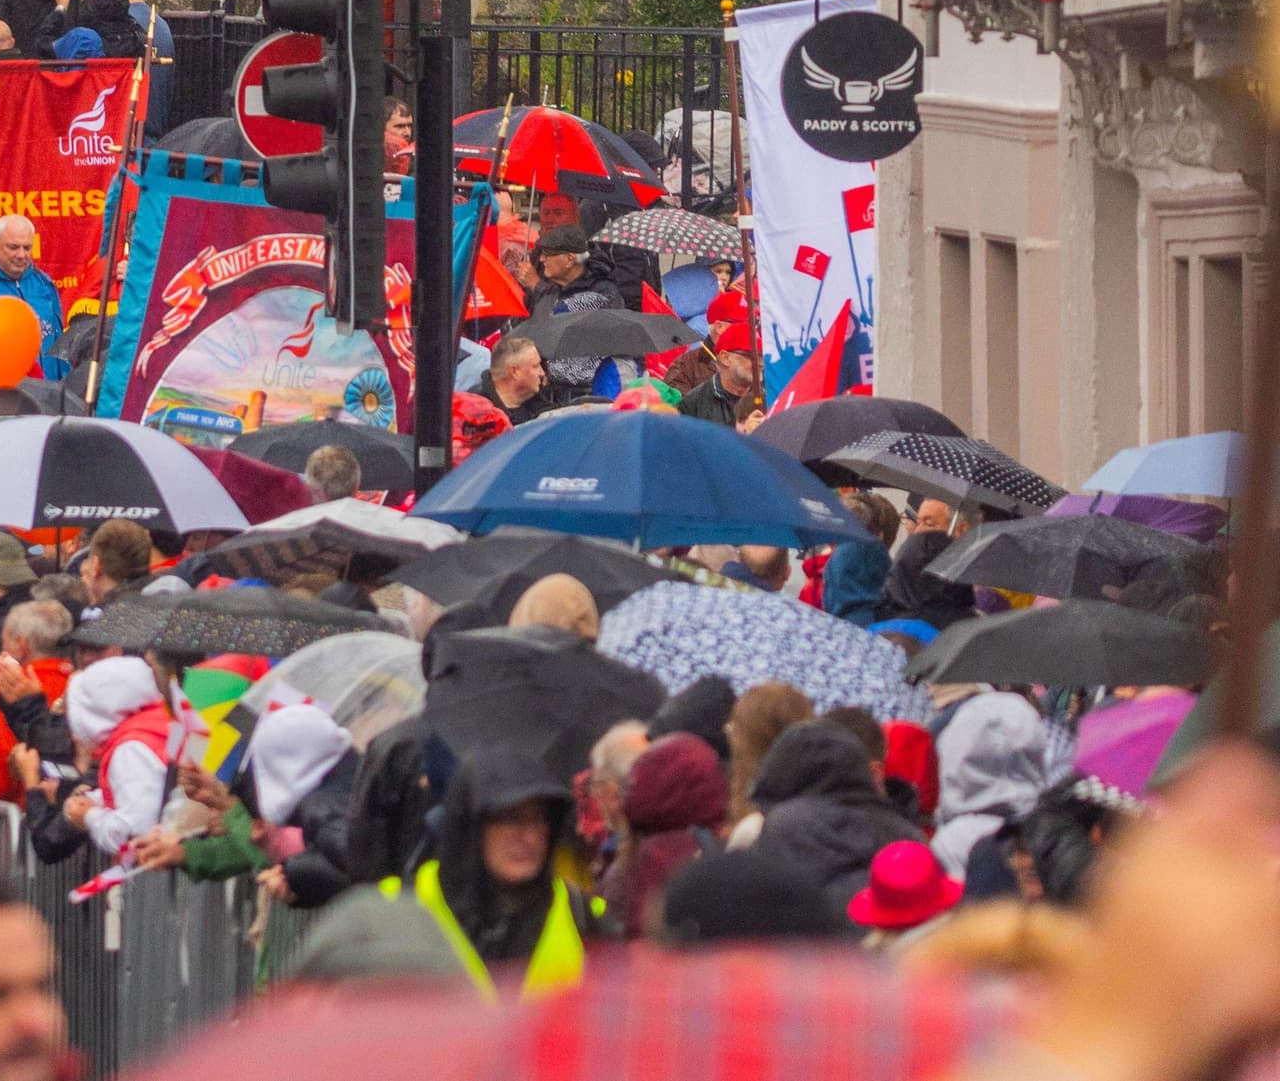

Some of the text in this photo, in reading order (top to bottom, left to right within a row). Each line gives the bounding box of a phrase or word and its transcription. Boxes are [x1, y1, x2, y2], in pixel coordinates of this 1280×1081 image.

[803, 120, 916, 132] PADDY & SCOTT'S
[58, 130, 115, 156] unite
[208, 247, 256, 281] UNITE
[257, 239, 305, 262] EAST
[262, 361, 317, 389] unite
[216, 415, 235, 428] NHS
[62, 505, 160, 518] DUNLOP
